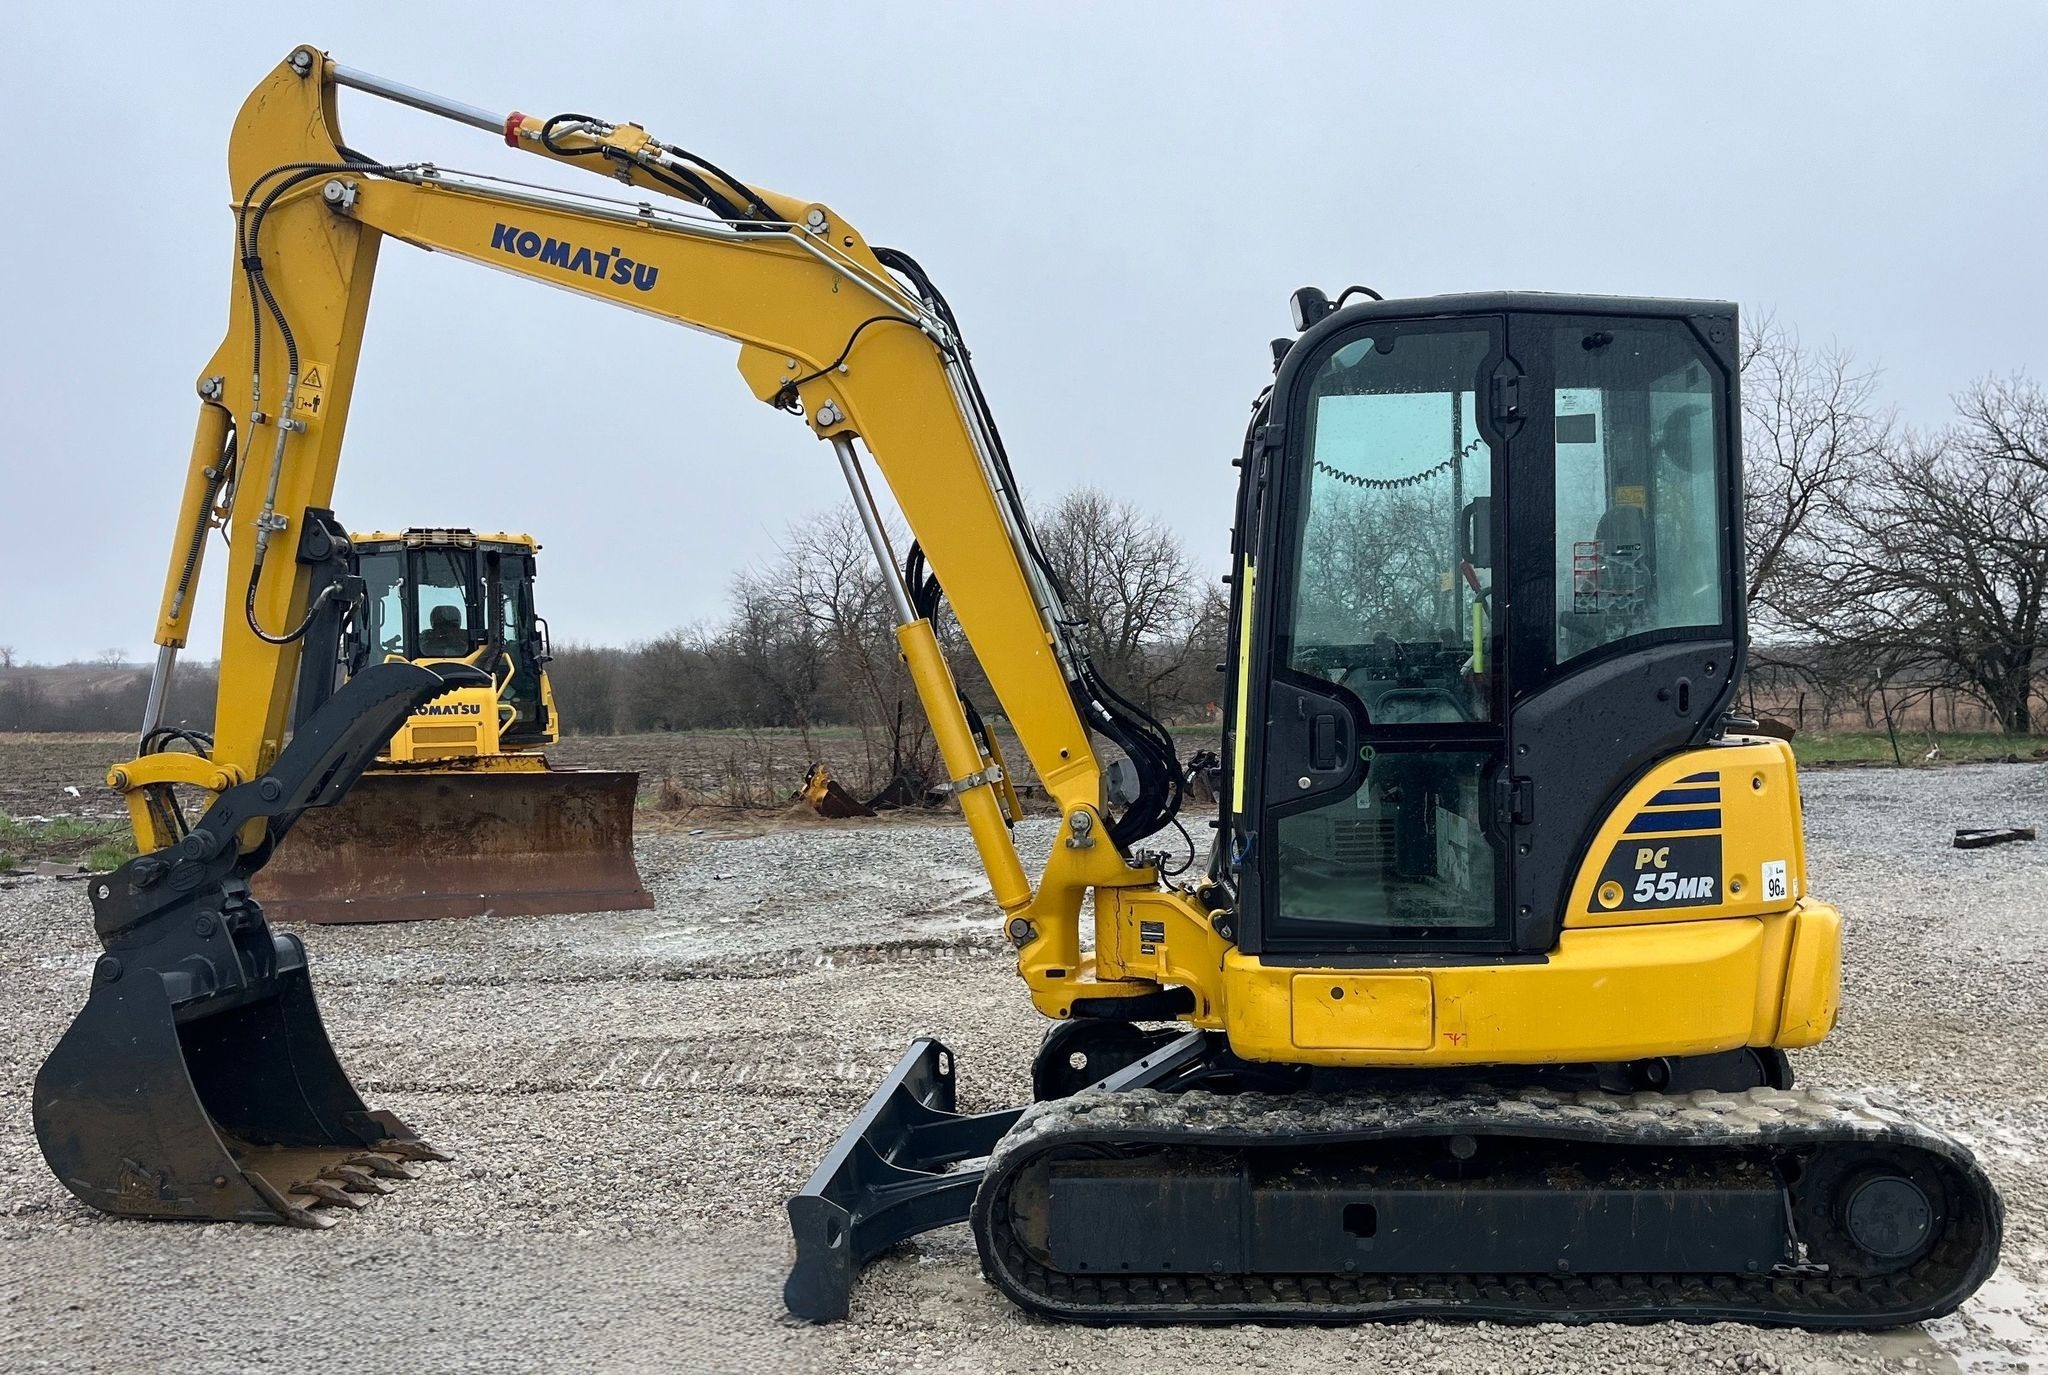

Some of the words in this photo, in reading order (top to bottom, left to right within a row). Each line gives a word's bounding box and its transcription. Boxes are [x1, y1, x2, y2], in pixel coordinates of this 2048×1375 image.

[491, 223, 658, 291] KOMATSU
[1635, 847, 1670, 869] PC
[1633, 872, 1713, 902] 55MR
[1769, 878, 1780, 897] 96
